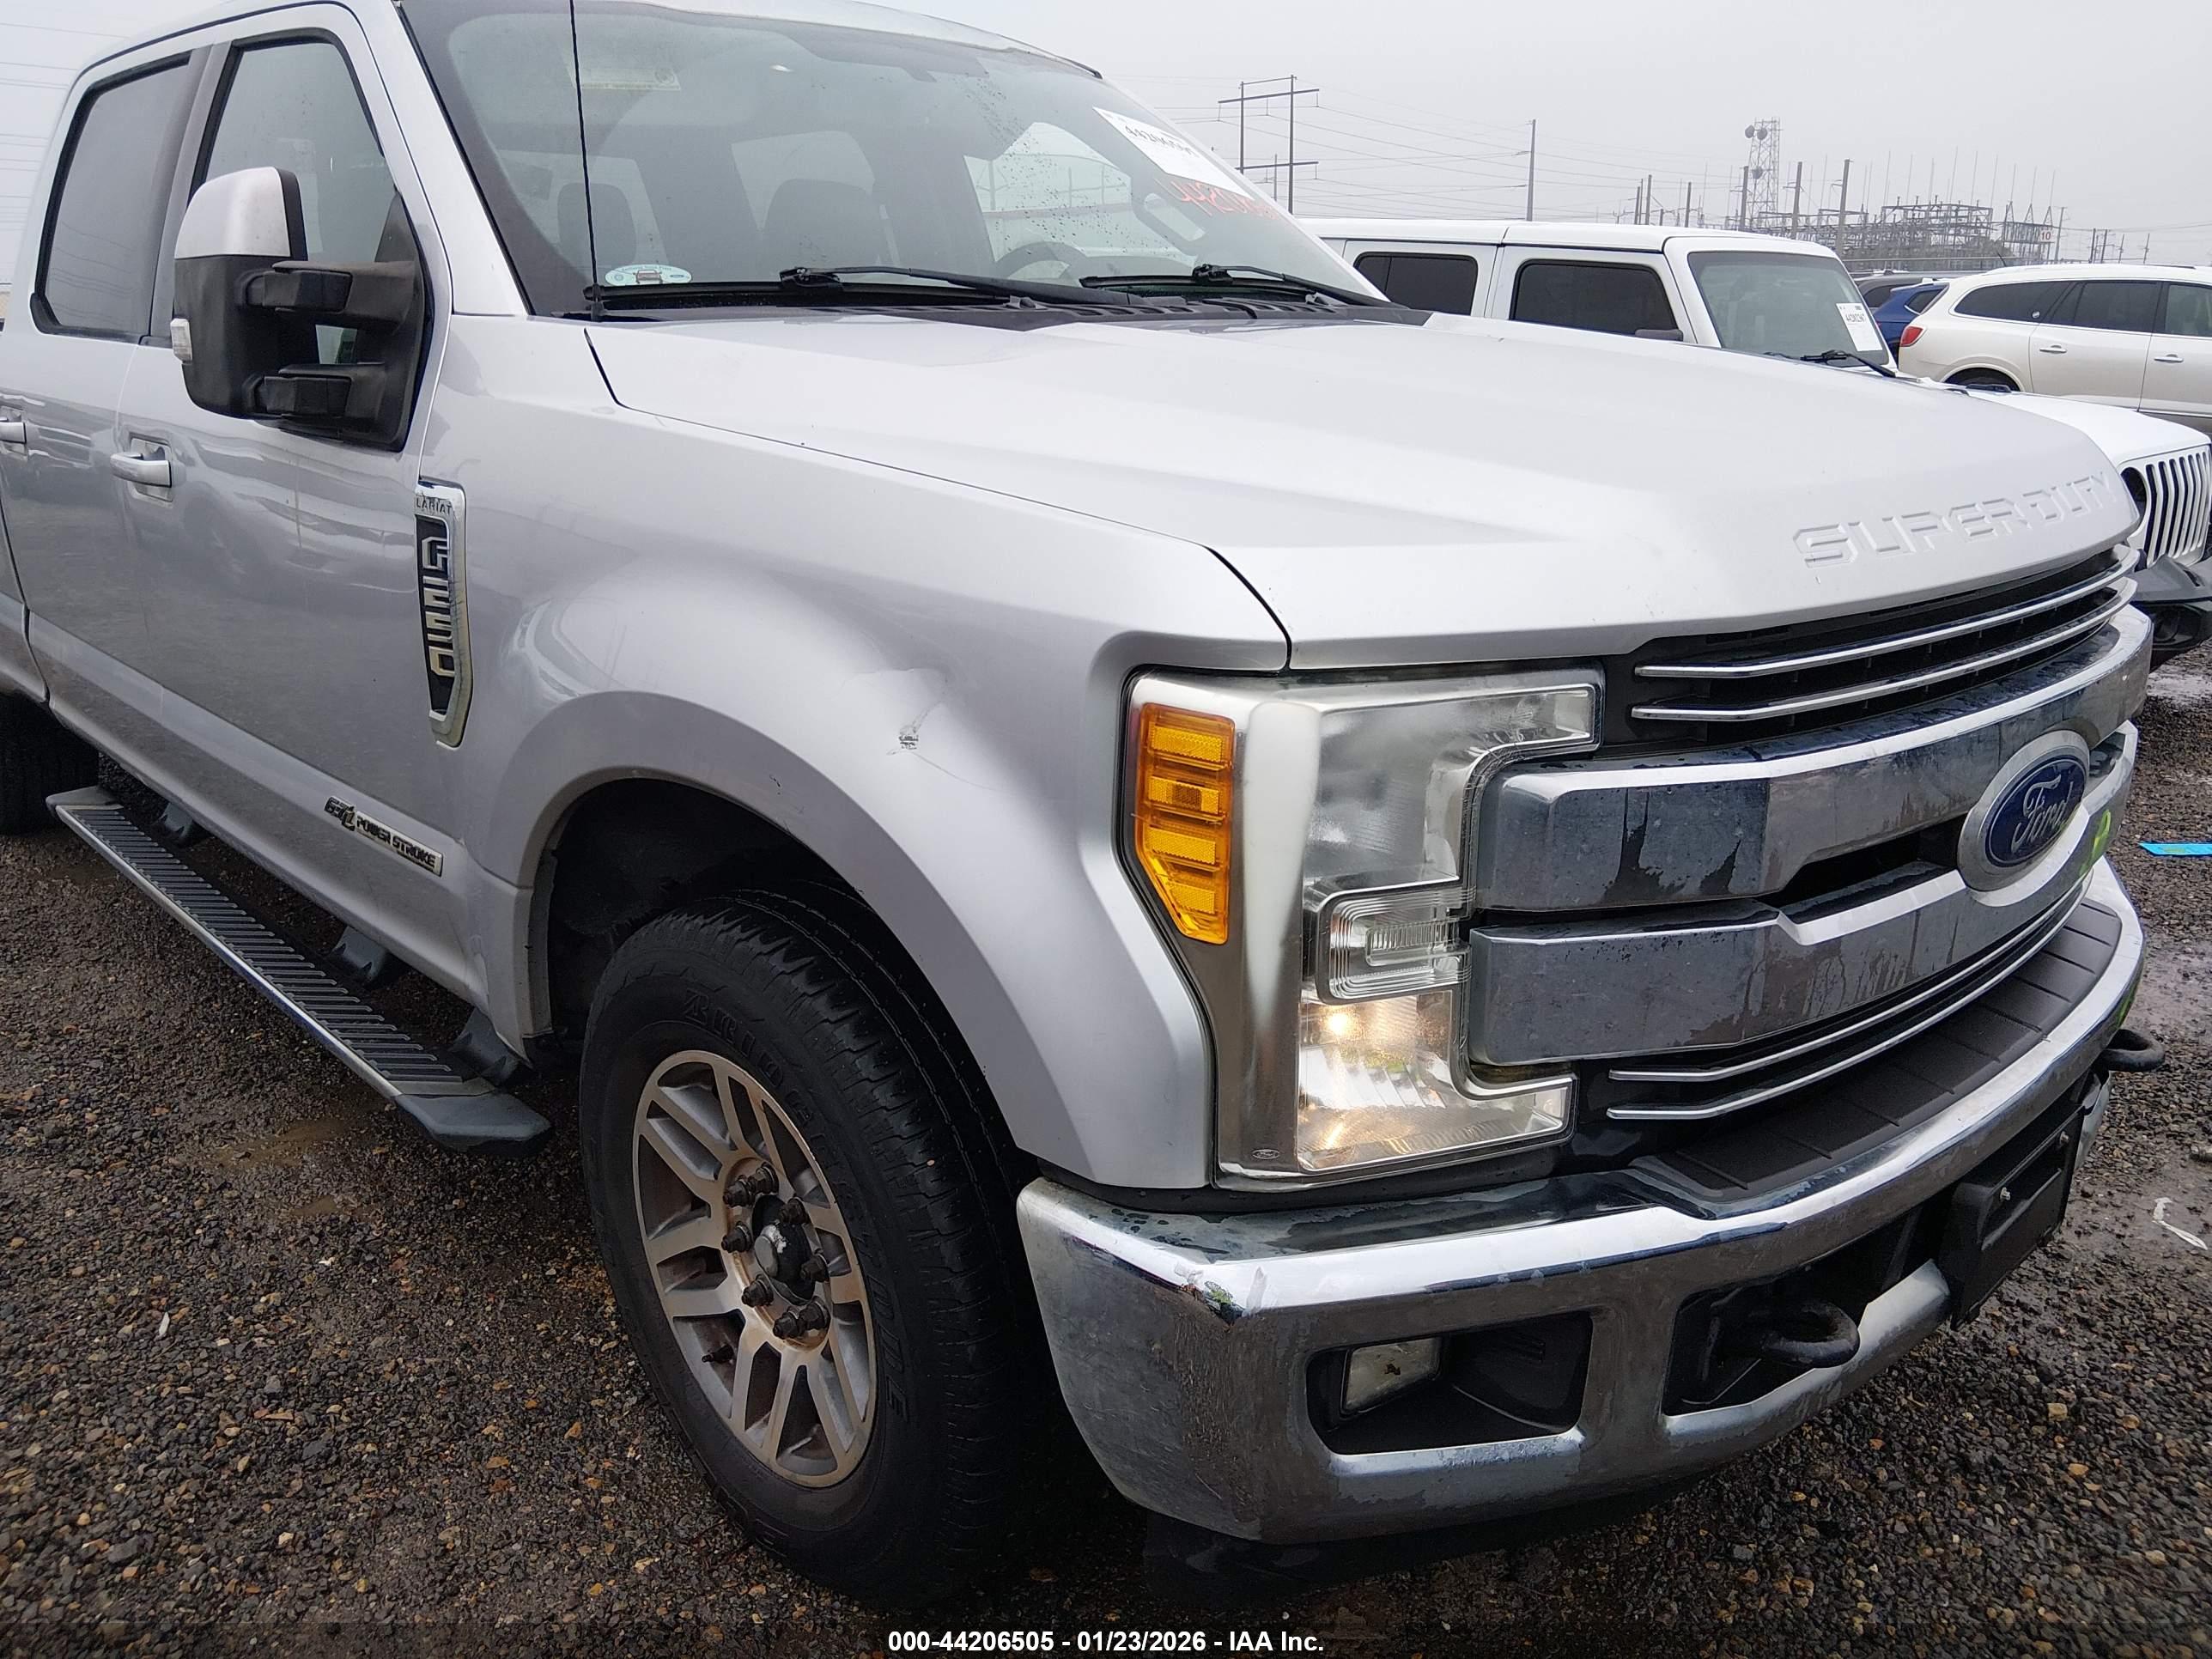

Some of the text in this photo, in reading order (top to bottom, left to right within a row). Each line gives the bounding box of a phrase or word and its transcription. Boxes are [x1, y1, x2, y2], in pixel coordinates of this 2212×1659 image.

[2041, 231, 2051, 240] 10
[416, 497, 453, 515] LARIAT
[1792, 471, 2118, 569] SUPER DUTY
[2010, 774, 2074, 854] Ford
[356, 815, 391, 845] POWER
[392, 835, 436, 868] STROKE
